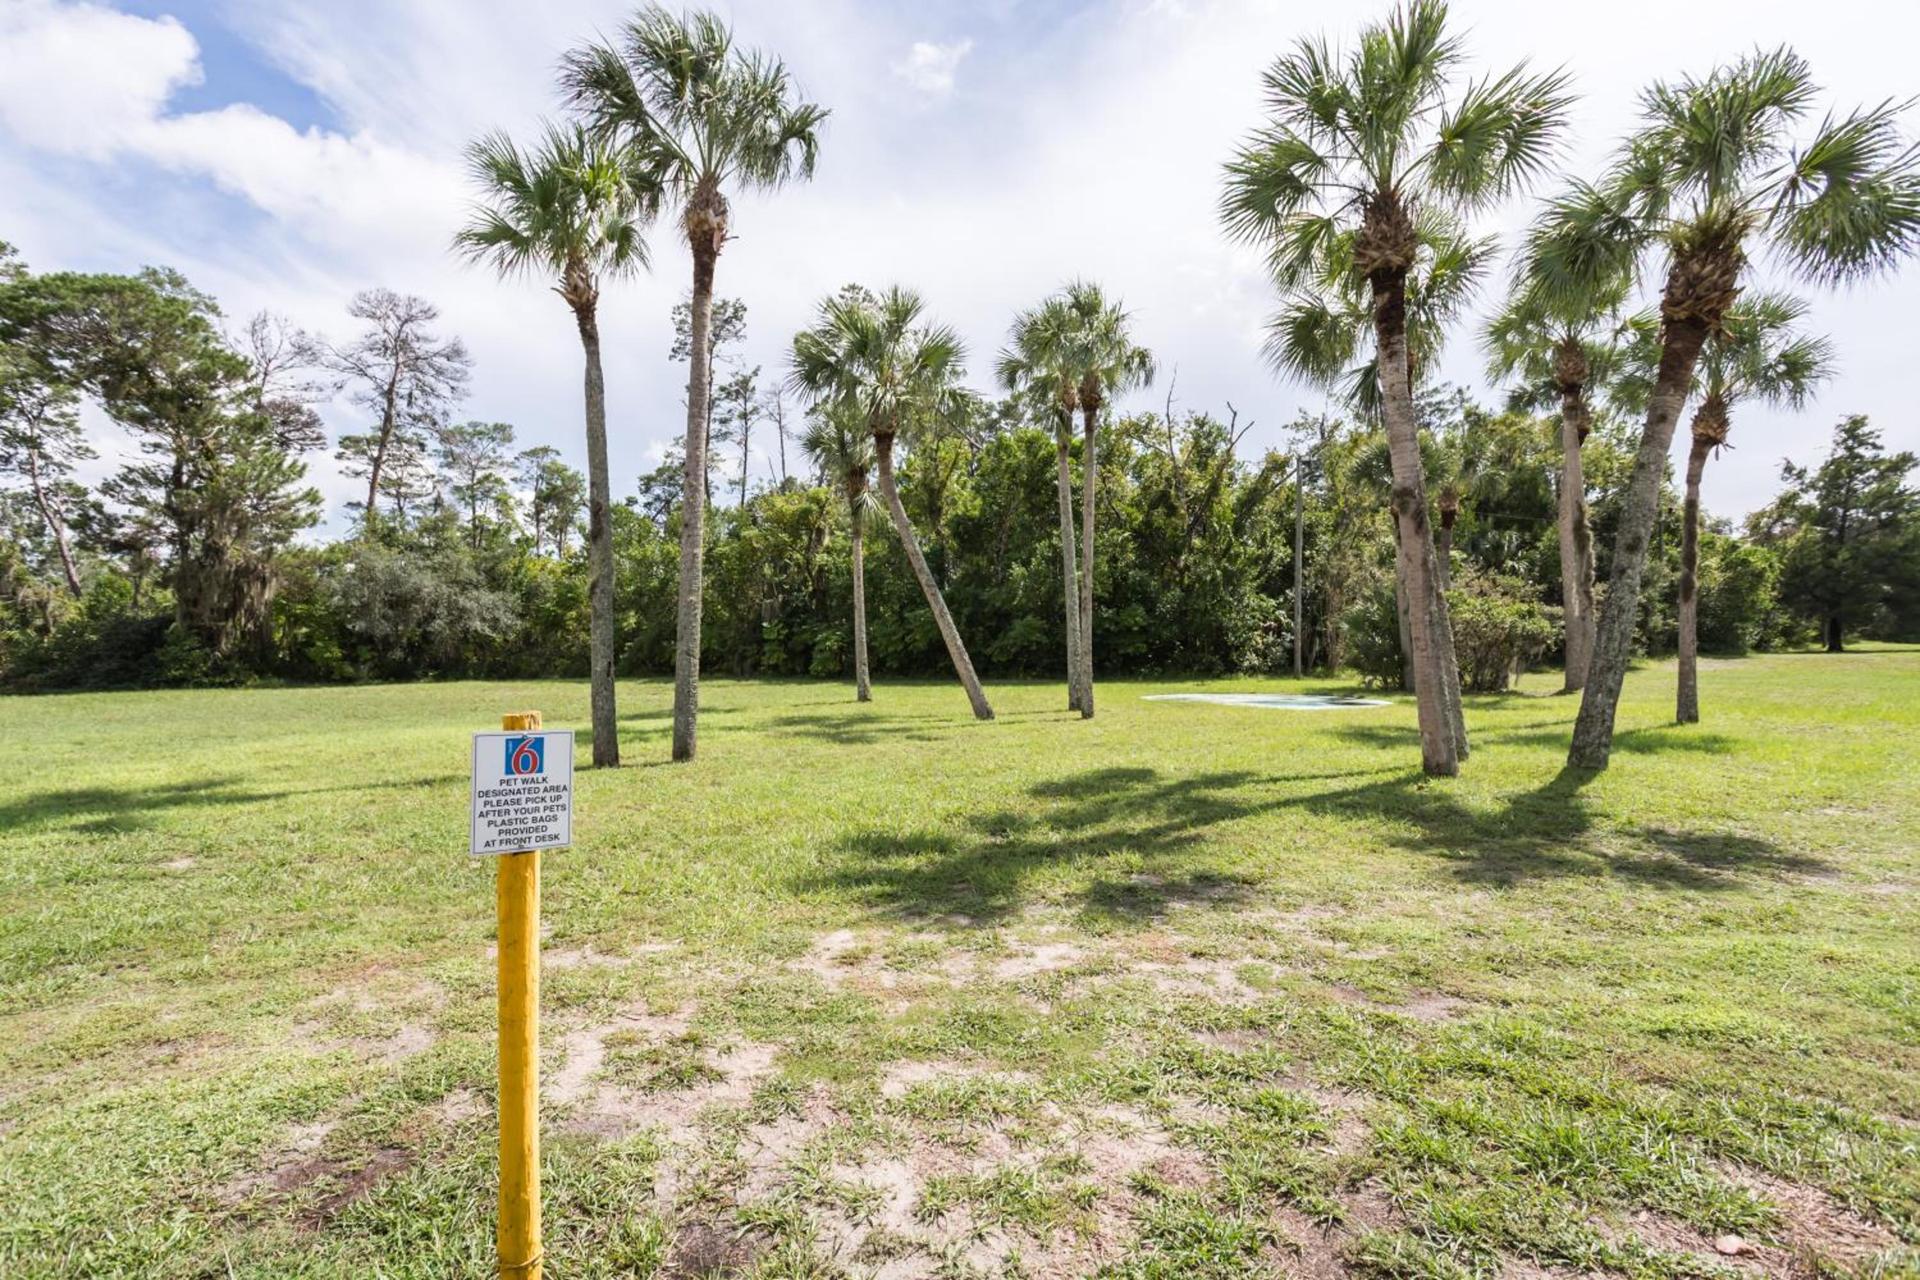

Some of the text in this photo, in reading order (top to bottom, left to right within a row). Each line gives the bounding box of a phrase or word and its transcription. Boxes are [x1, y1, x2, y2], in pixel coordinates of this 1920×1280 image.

[512, 738, 539, 776] 6
[500, 776, 548, 787] PET WALK
[477, 784, 568, 798] DESIGNATED AREA
[483, 794, 562, 808] PLEASE PICK UP
[478, 803, 567, 818] AFTER YOUR PETS
[487, 814, 558, 828] PLASTIC BAGS
[498, 825, 548, 836] PROVIDED
[484, 833, 560, 848] AT FRONT DESK
